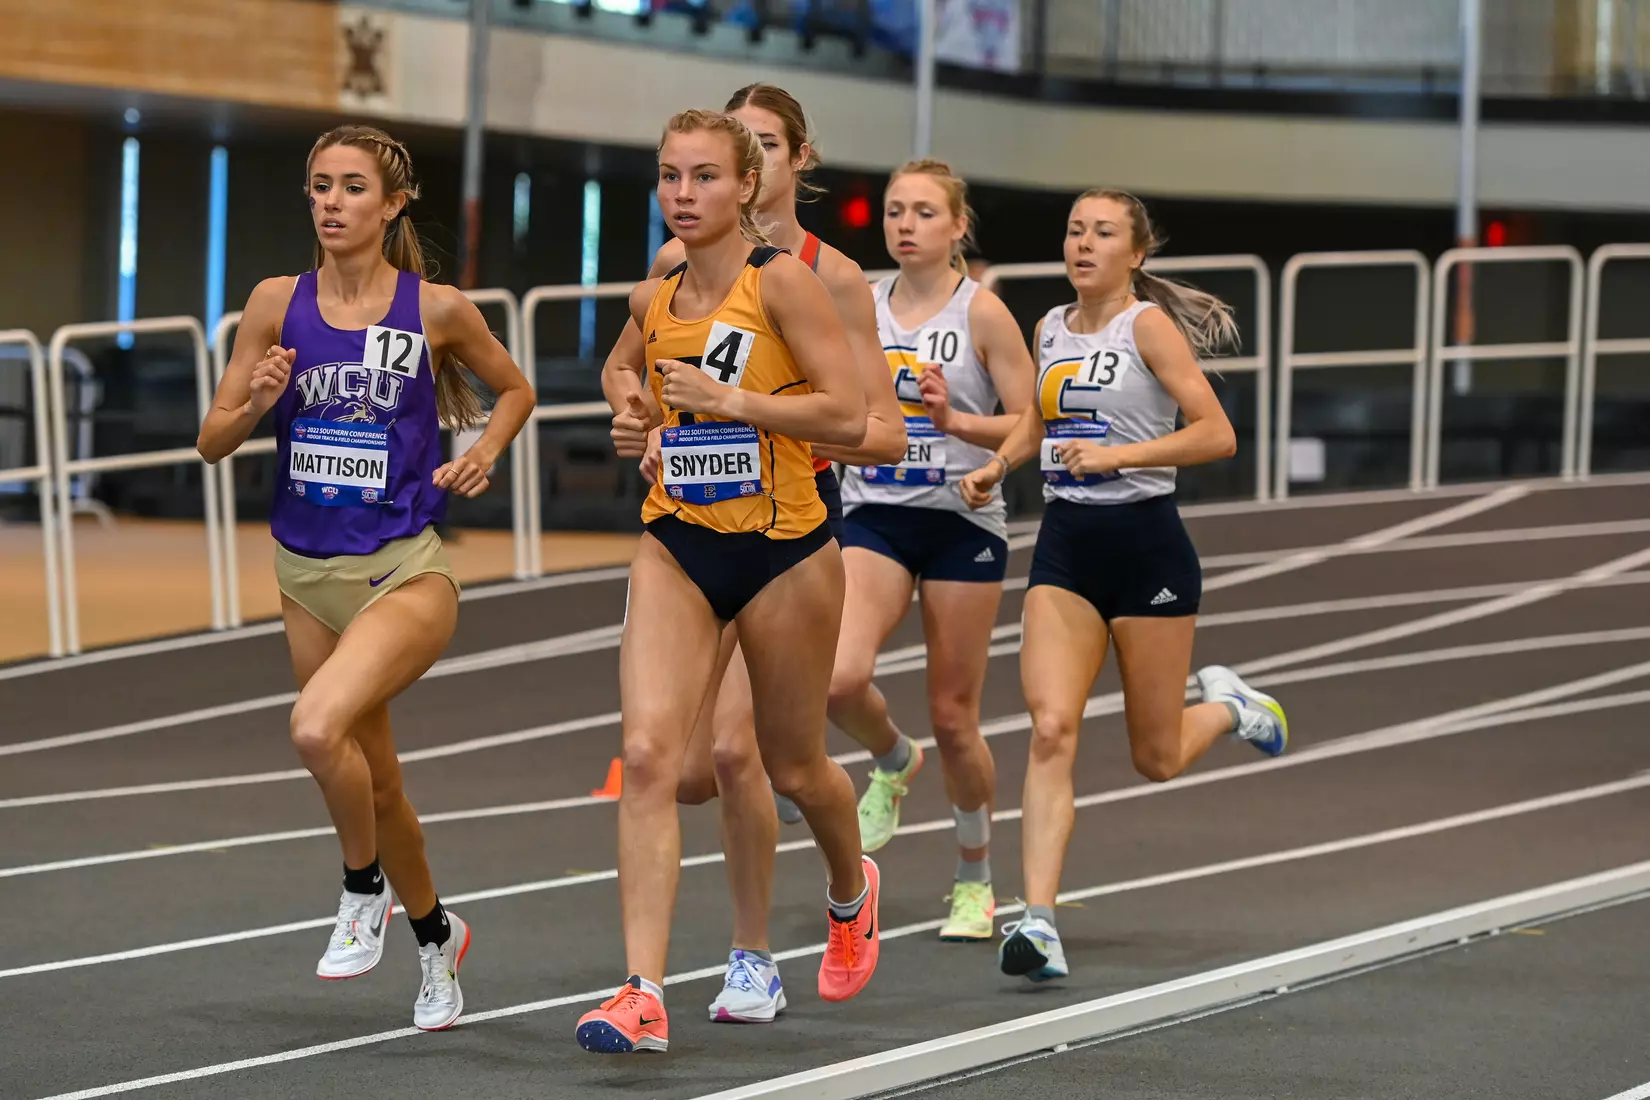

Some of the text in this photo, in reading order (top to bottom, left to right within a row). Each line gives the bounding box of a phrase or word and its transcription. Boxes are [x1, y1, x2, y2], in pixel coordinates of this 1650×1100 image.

[376, 330, 413, 373] 12
[705, 330, 744, 382] 4
[927, 331, 958, 362] 10
[1087, 350, 1119, 385] 13
[296, 362, 404, 411] WCU
[307, 426, 319, 434] 2022
[319, 428, 348, 436] SOUTHERN
[349, 430, 387, 440] CONFERENCE
[350, 438, 387, 446] CHAMPIONSHIPS
[691, 428, 720, 436] SOUTHERN
[720, 426, 756, 434] CONFERENCE
[292, 451, 384, 480] MATTISON
[670, 452, 752, 478] SNYDER
[321, 486, 339, 495] WCU
